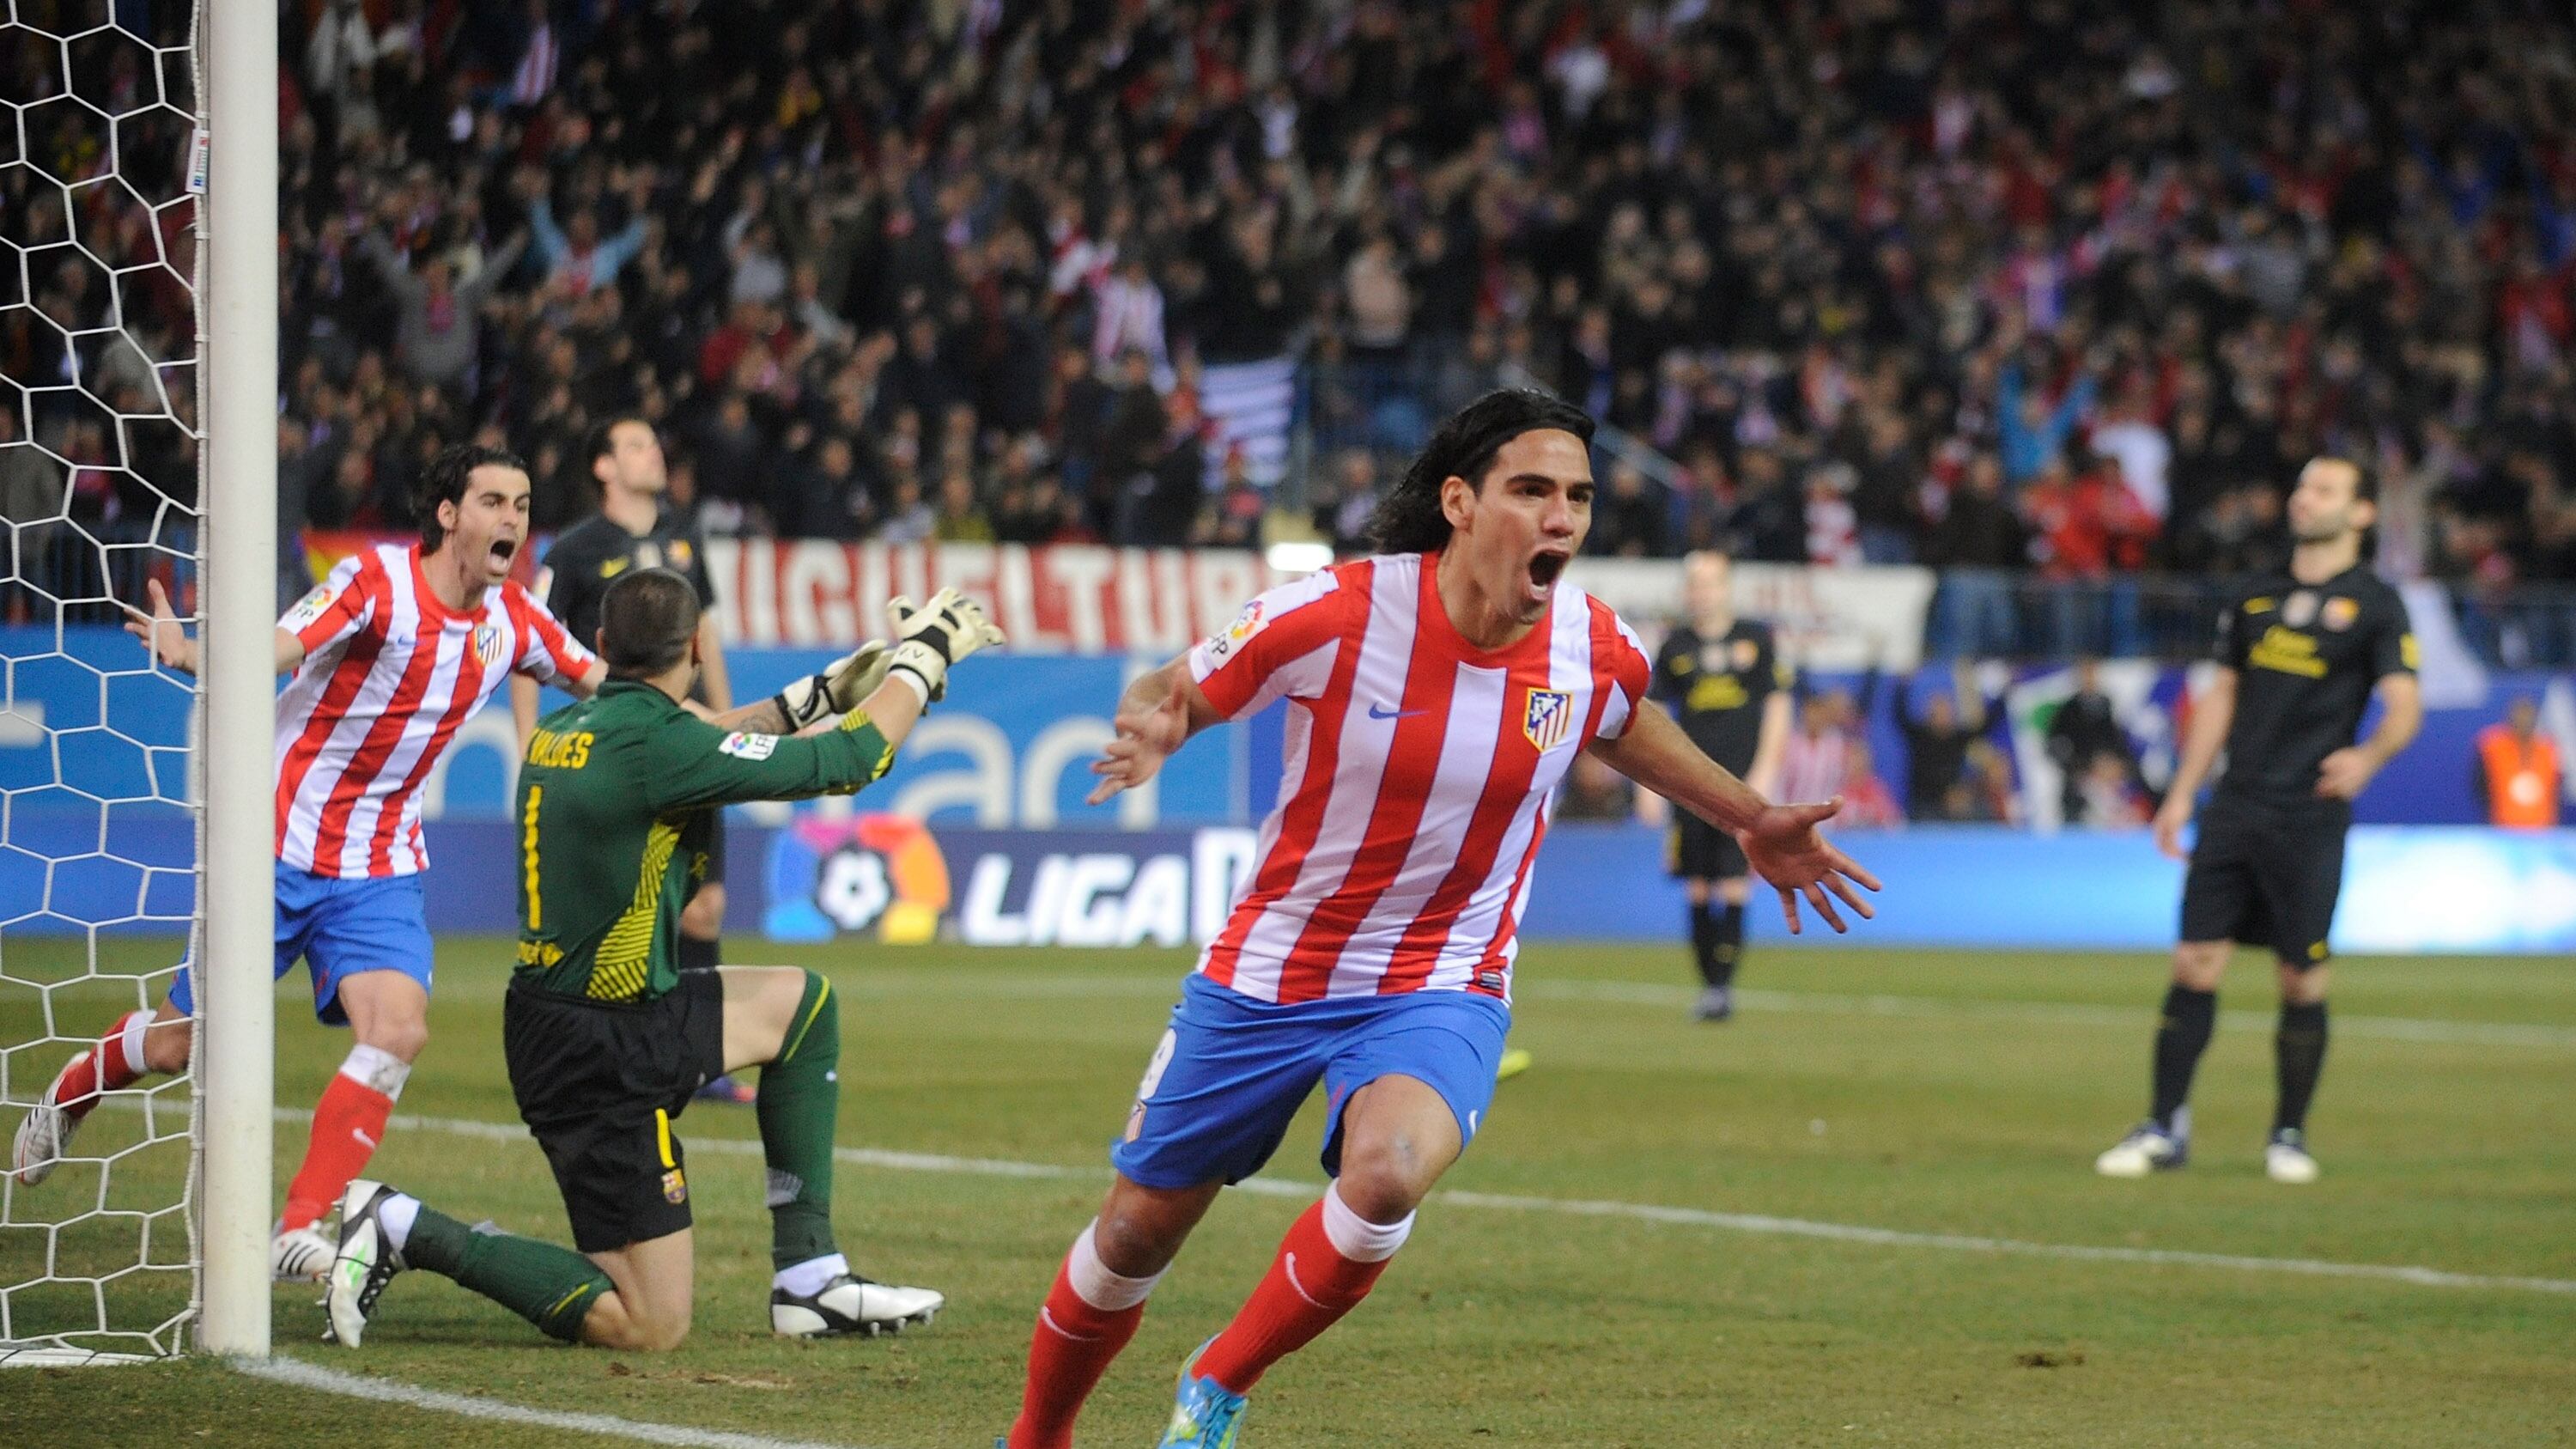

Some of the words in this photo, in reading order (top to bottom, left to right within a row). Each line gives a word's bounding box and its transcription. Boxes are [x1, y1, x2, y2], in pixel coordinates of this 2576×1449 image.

[524, 783, 543, 931] 1
[960, 853, 1190, 947] LIGA
[655, 1107, 677, 1168] 1
